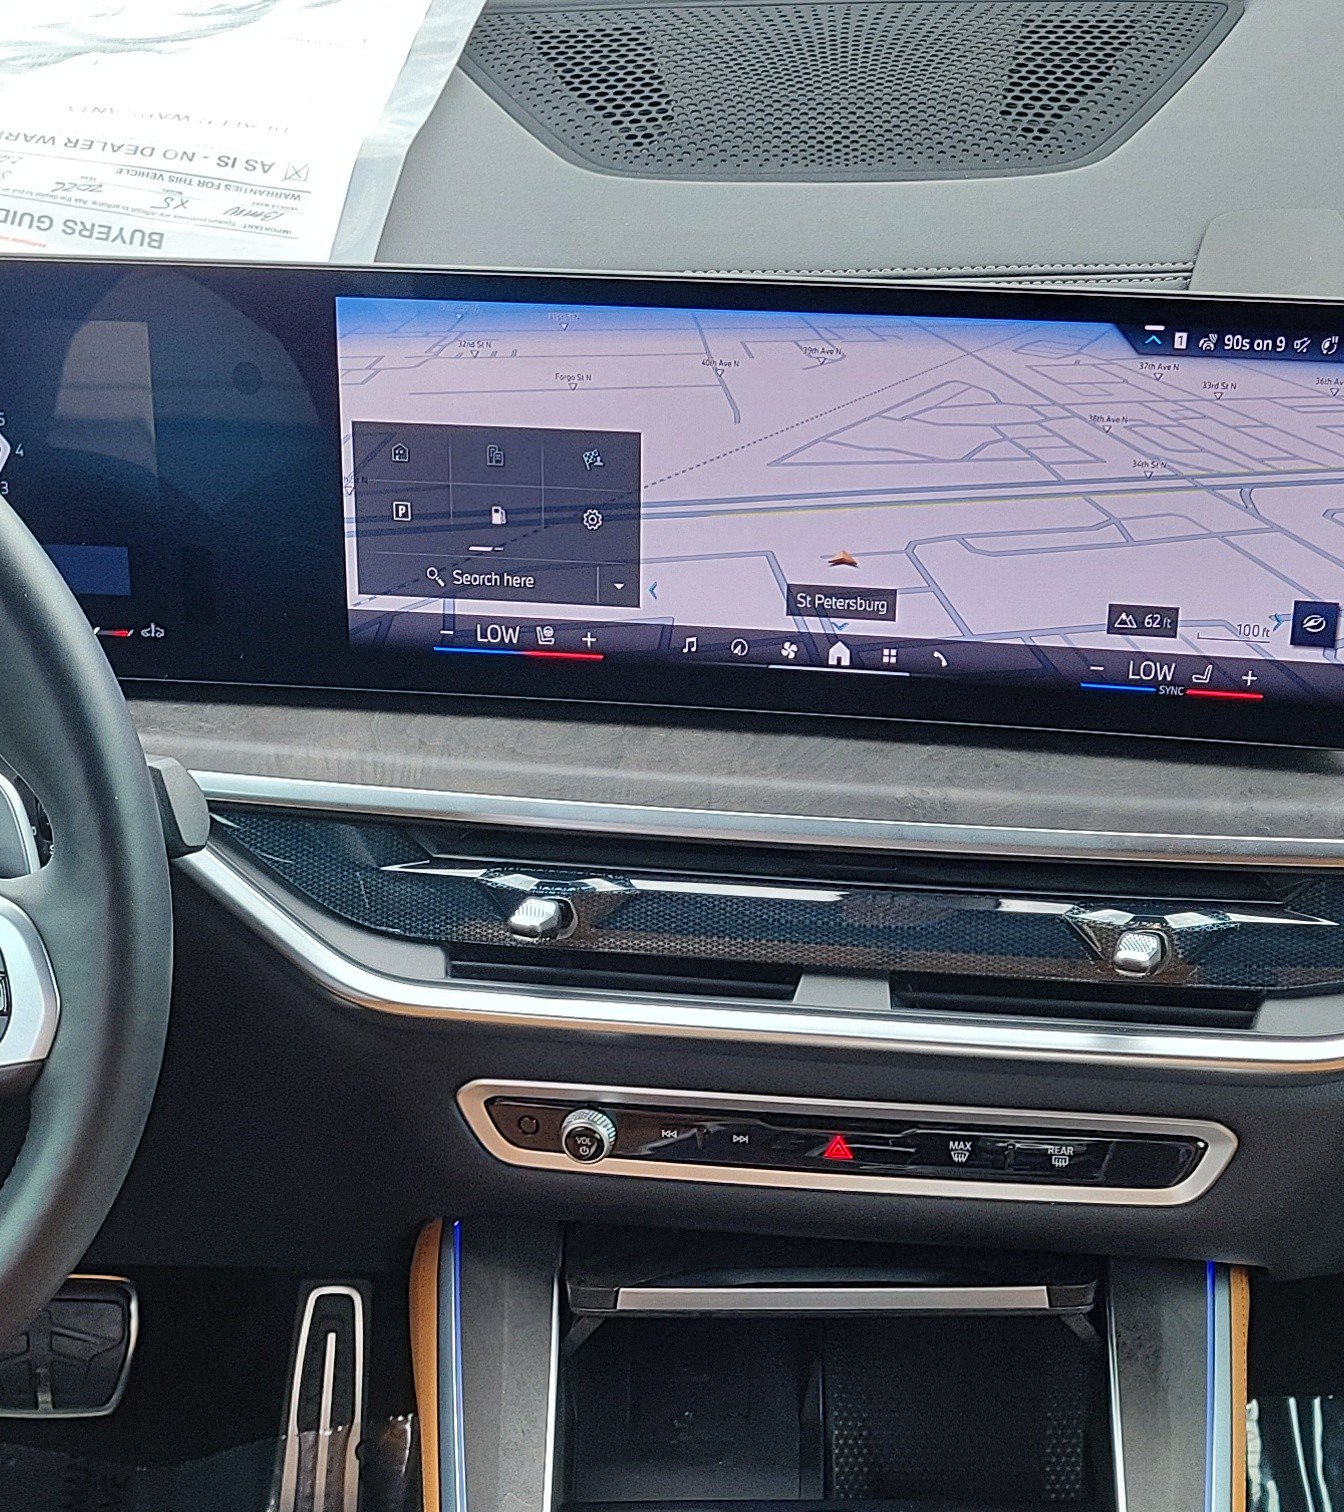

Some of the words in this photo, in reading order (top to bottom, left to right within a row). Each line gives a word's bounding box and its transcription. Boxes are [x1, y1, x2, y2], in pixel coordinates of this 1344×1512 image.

[64, 137, 156, 159] DEALER
[163, 148, 196, 166] NO
[216, 154, 237, 169] IS
[245, 158, 275, 174] AS
[62, 218, 164, 251] BUYERS
[1223, 333, 1252, 352] 90s
[1253, 337, 1274, 352] on
[1276, 335, 1286, 353] 9
[15, 443, 24, 457] 4
[0, 481, 9, 495] 3
[452, 569, 500, 587] Search
[503, 571, 535, 589] here
[796, 592, 812, 609] St
[814, 593, 888, 616] Petersburg
[1143, 612, 1162, 630] 62
[476, 623, 520, 645] LOW
[1237, 622, 1260, 639] 100
[1128, 659, 1176, 681] LOW
[1158, 684, 1185, 697] SYNC
[574, 1136, 593, 1146] VOL
[948, 1140, 973, 1151] MAX
[1047, 1146, 1074, 1156] REAR
